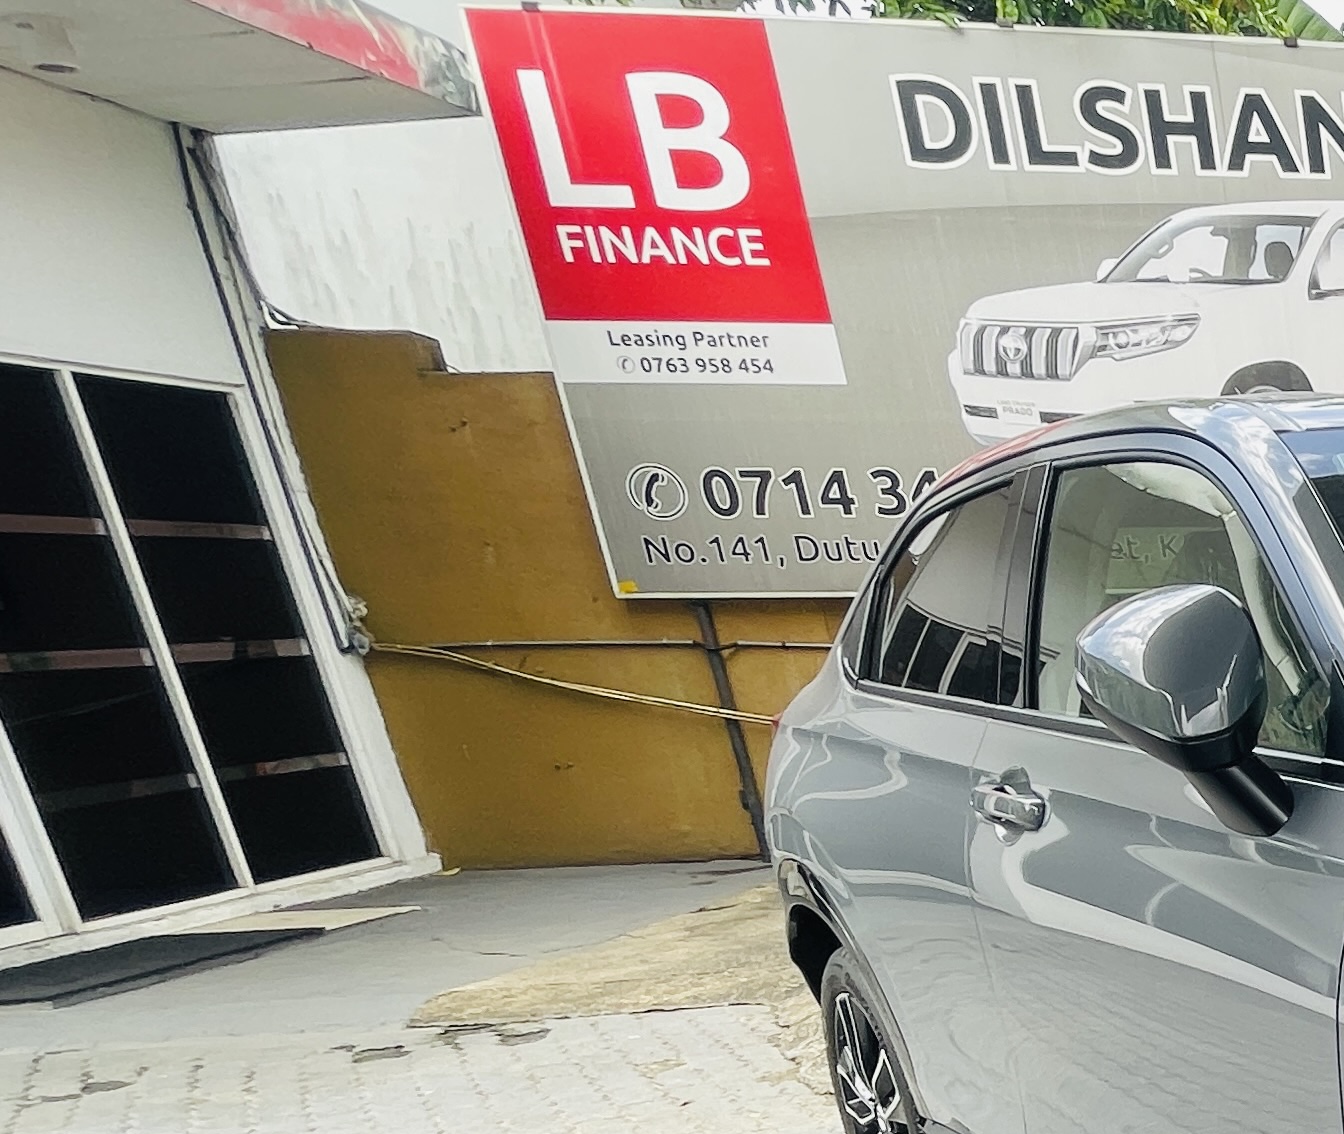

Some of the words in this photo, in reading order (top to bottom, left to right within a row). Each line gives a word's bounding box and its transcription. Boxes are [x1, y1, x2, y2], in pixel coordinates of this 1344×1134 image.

[516, 68, 752, 213] LB
[555, 224, 771, 267] FINANCE
[606, 329, 688, 351] Leasing
[692, 331, 770, 348] Partner
[640, 356, 690, 374] 0763
[695, 357, 733, 374] 958
[738, 358, 775, 374] 454
[700, 466, 858, 519] 0714
[640, 534, 788, 570] No.141,
